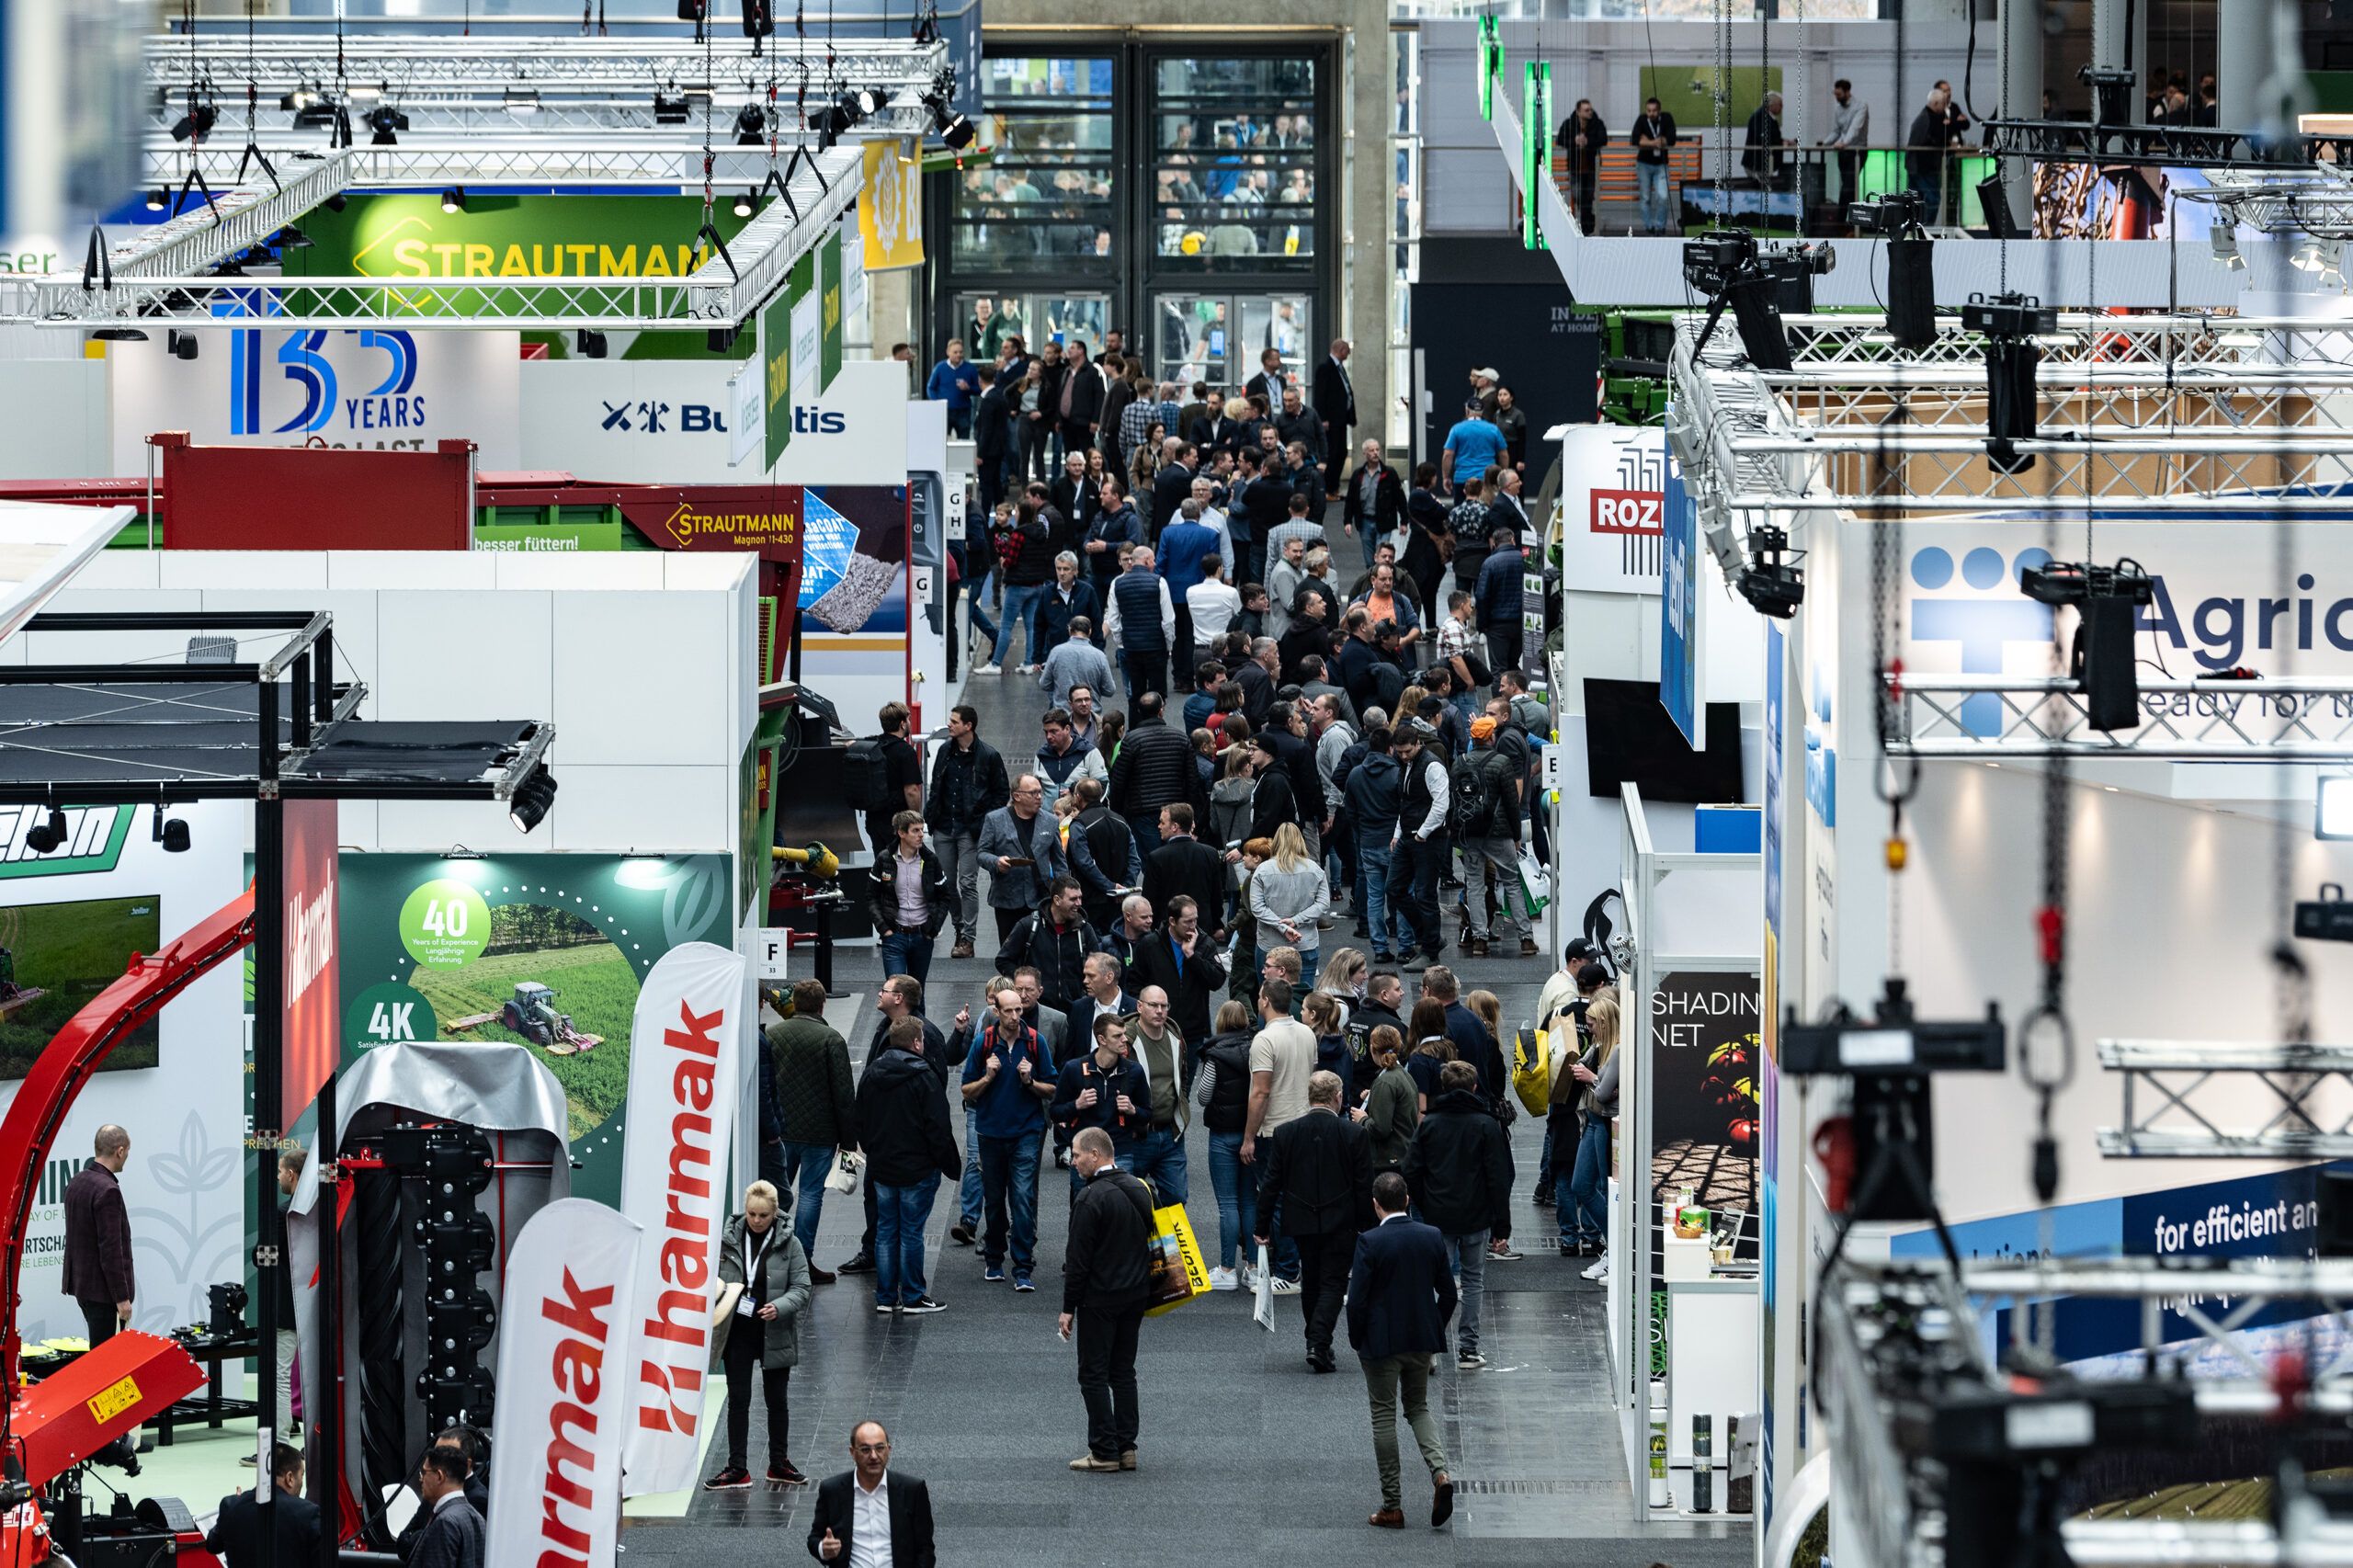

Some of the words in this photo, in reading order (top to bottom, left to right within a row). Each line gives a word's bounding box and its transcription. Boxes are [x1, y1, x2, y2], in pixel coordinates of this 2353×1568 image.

[346, 396, 425, 429] YEARS
[949, 494, 960, 505] G
[1597, 497, 1665, 529] ROZ
[678, 513, 794, 536] STRAUTMANN
[951, 517, 961, 527] H
[474, 537, 521, 551] besser
[525, 535, 579, 551] füttern!
[734, 535, 766, 547] Magnon
[916, 578, 927, 591] G
[1550, 757, 1557, 773] E
[422, 899, 468, 937] 40
[295, 858, 334, 1004] harmak
[432, 937, 439, 946] of
[441, 938, 479, 947] Experience
[426, 947, 465, 957] Langjährige
[768, 944, 778, 960] F
[1652, 992, 1761, 1016] SHADIN
[368, 1002, 415, 1040] 4K
[644, 997, 723, 1351] harmak
[44, 1210, 58, 1221] OF
[2155, 1215, 2188, 1253] for
[2193, 1199, 2287, 1248] efficient
